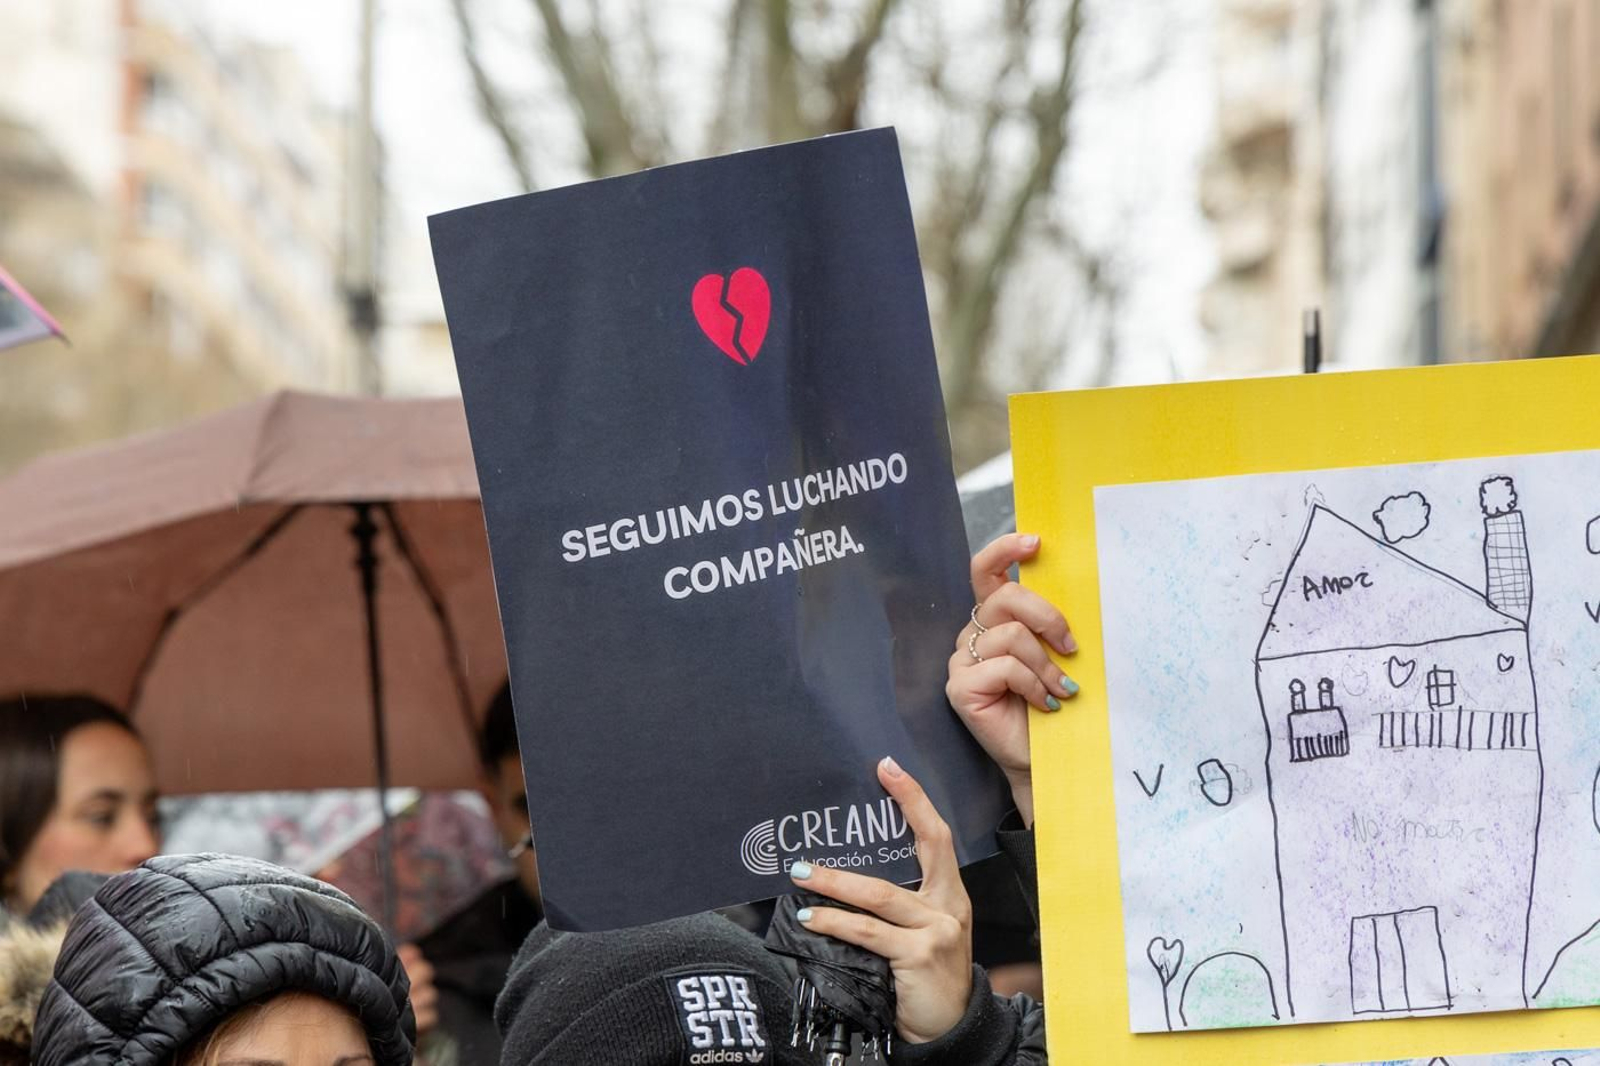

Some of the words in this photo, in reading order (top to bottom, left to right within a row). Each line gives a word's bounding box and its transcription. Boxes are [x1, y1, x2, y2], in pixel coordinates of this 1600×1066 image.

[561, 488, 764, 563] SEGUIMOS
[768, 453, 908, 515] LUCHANDO
[663, 525, 865, 600] COMPAÑERA.
[783, 852, 873, 873] Eucación
[677, 976, 757, 1011] SPR
[687, 1010, 766, 1048] STR
[690, 1049, 743, 1064] adidas
